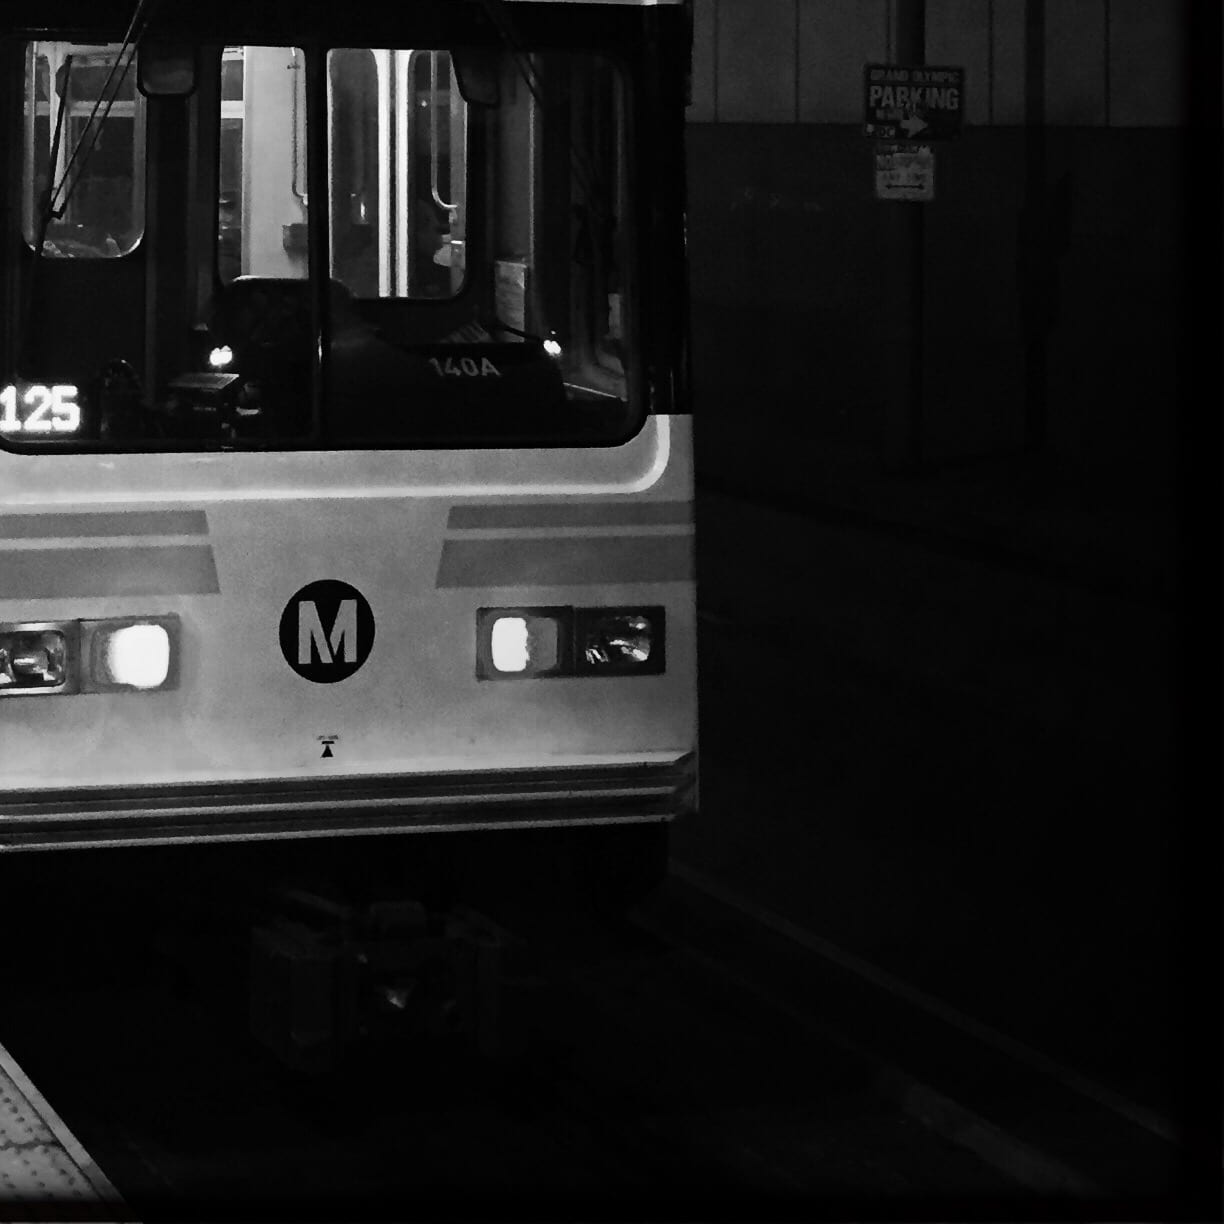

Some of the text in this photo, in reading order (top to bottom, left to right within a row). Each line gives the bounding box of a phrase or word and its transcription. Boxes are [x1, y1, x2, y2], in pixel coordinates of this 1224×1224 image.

[869, 85, 959, 112] PARKING
[429, 356, 502, 377] 140A
[297, 599, 358, 665] M
